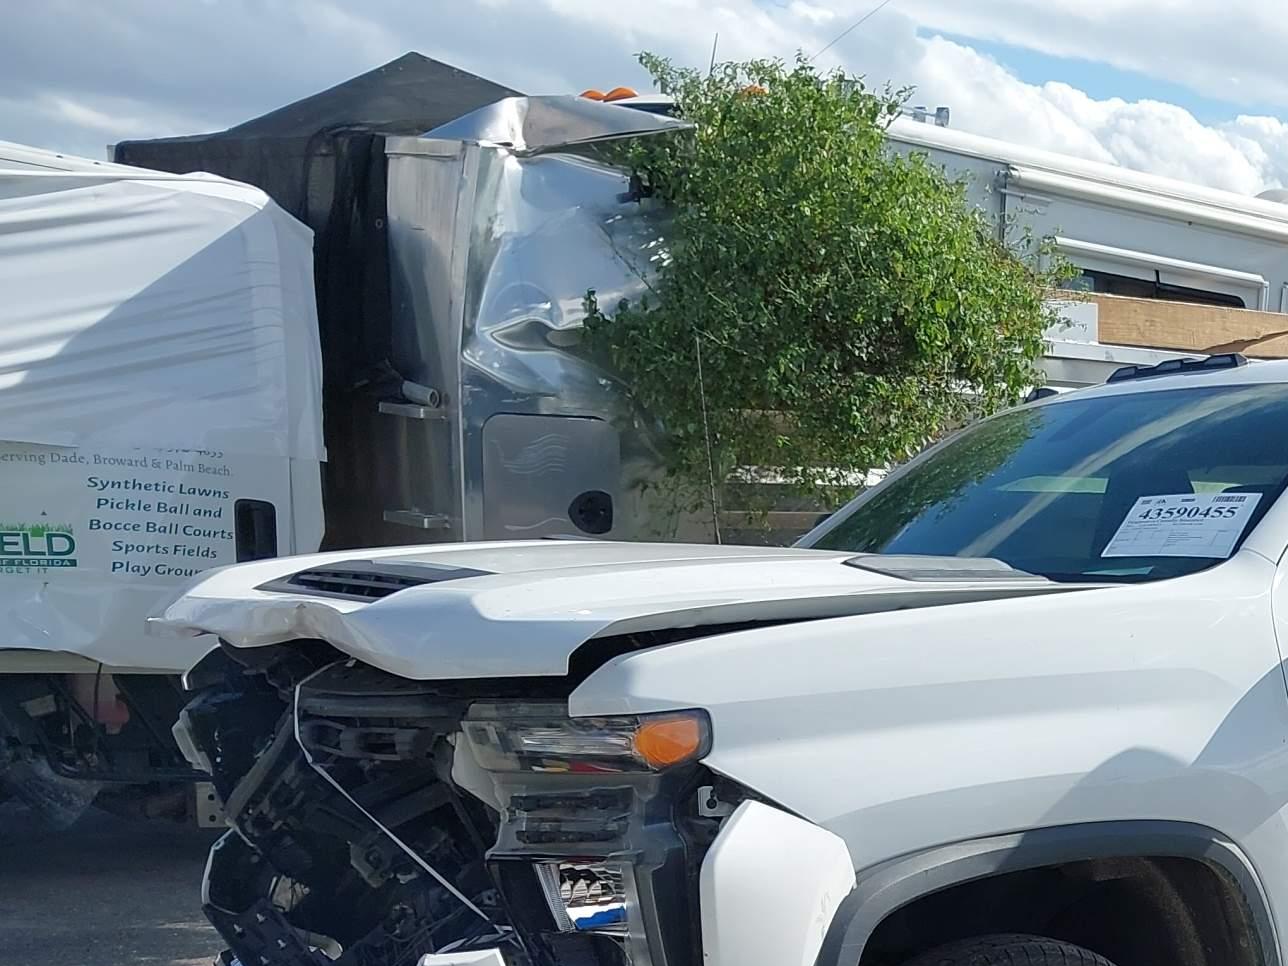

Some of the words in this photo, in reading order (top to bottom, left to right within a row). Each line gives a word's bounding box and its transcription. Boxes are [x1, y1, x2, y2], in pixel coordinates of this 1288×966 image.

[0, 451, 46, 466] erving
[50, 452, 89, 465] Dade,
[93, 454, 148, 469] Broward
[151, 458, 162, 469] &
[165, 460, 194, 473] Palm
[87, 476, 175, 493] Synthetic
[179, 483, 230, 499] Lawns
[96, 498, 152, 512] Pickle
[157, 502, 190, 515] Ball
[193, 507, 223, 519] and
[1139, 506, 1240, 520] 43590455
[88, 519, 141, 532] Bocce
[146, 522, 179, 535] Ball
[183, 525, 234, 540] Courts
[112, 540, 169, 555] Sports
[173, 544, 217, 559] Fields
[14, 559, 71, 567] FLORIDA
[111, 561, 151, 577] Play
